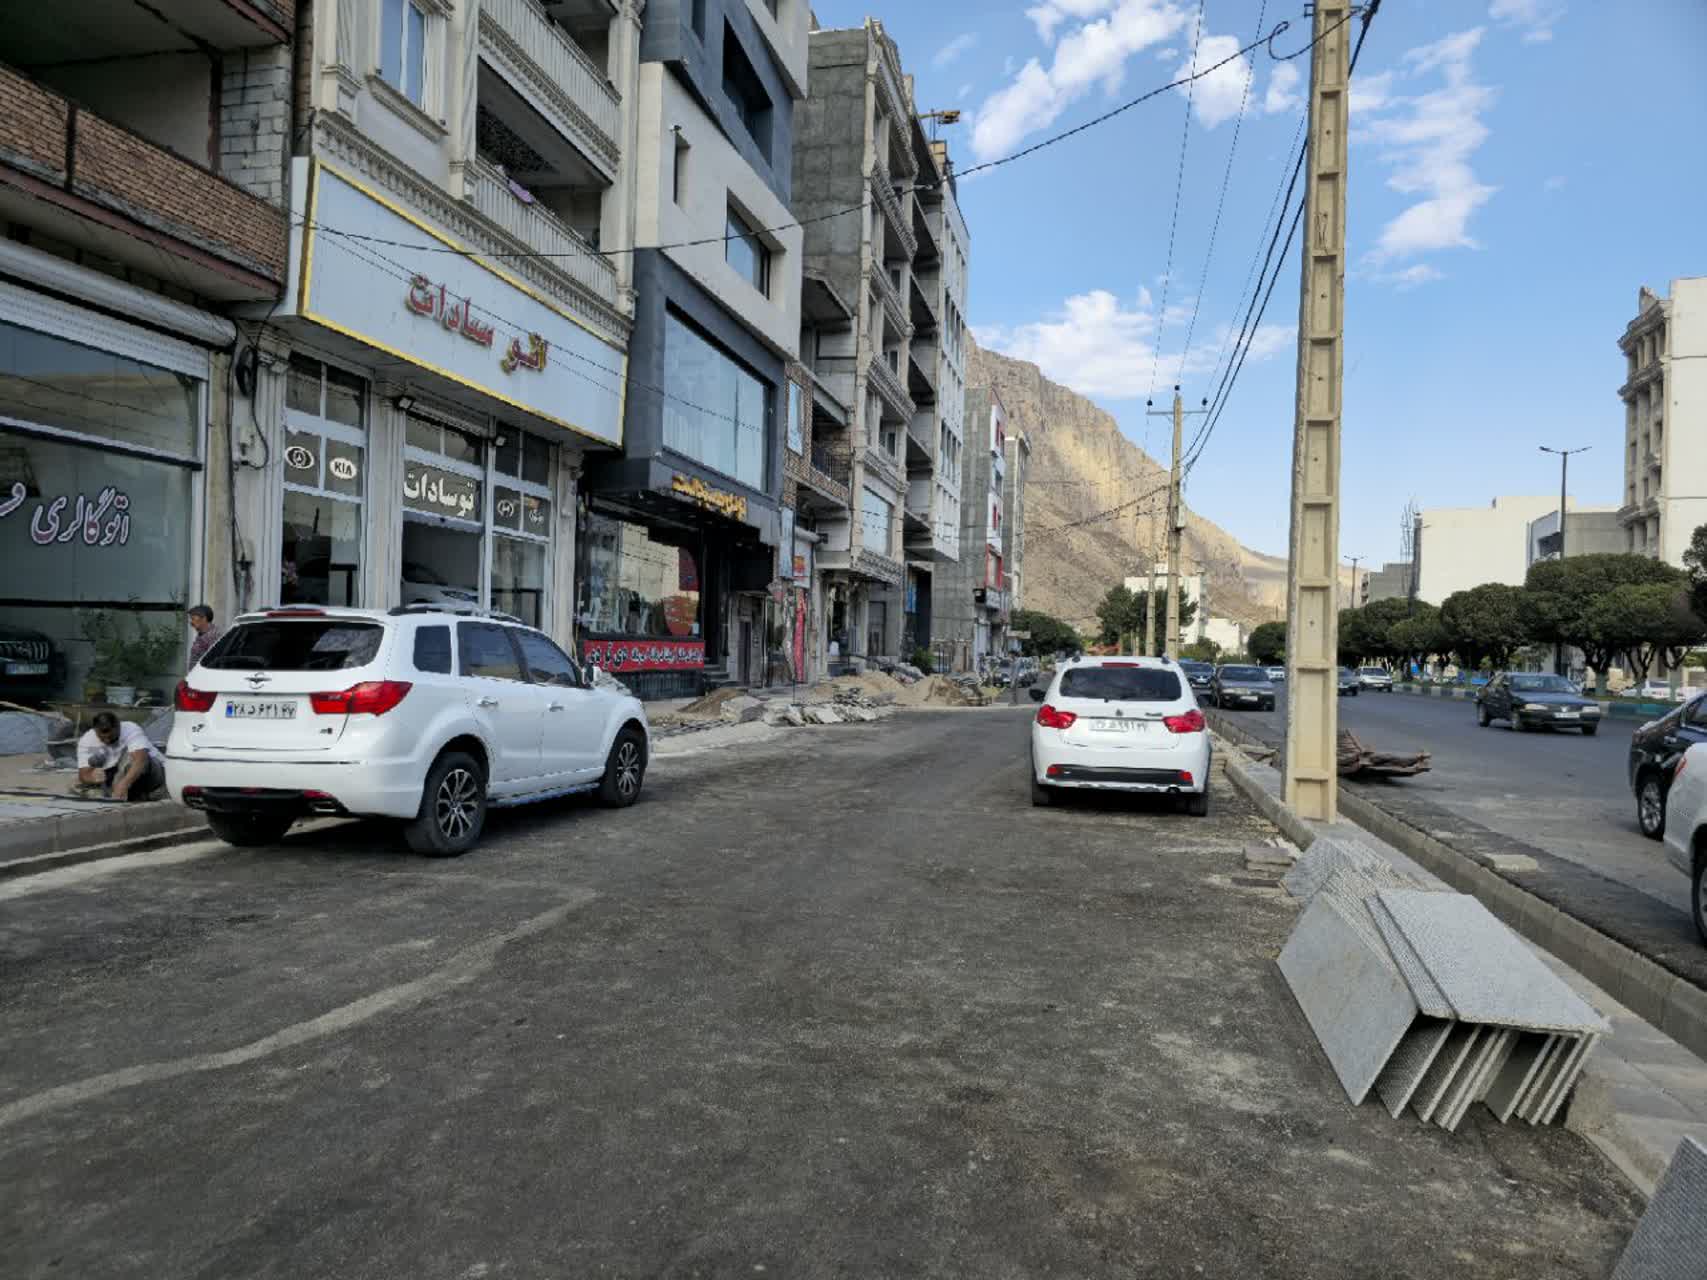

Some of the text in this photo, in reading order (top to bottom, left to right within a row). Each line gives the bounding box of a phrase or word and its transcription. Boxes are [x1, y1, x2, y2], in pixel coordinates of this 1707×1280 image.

[404, 274, 496, 348] سادات
[334, 461, 353, 476] KIA
[403, 472, 458, 507] سادات
